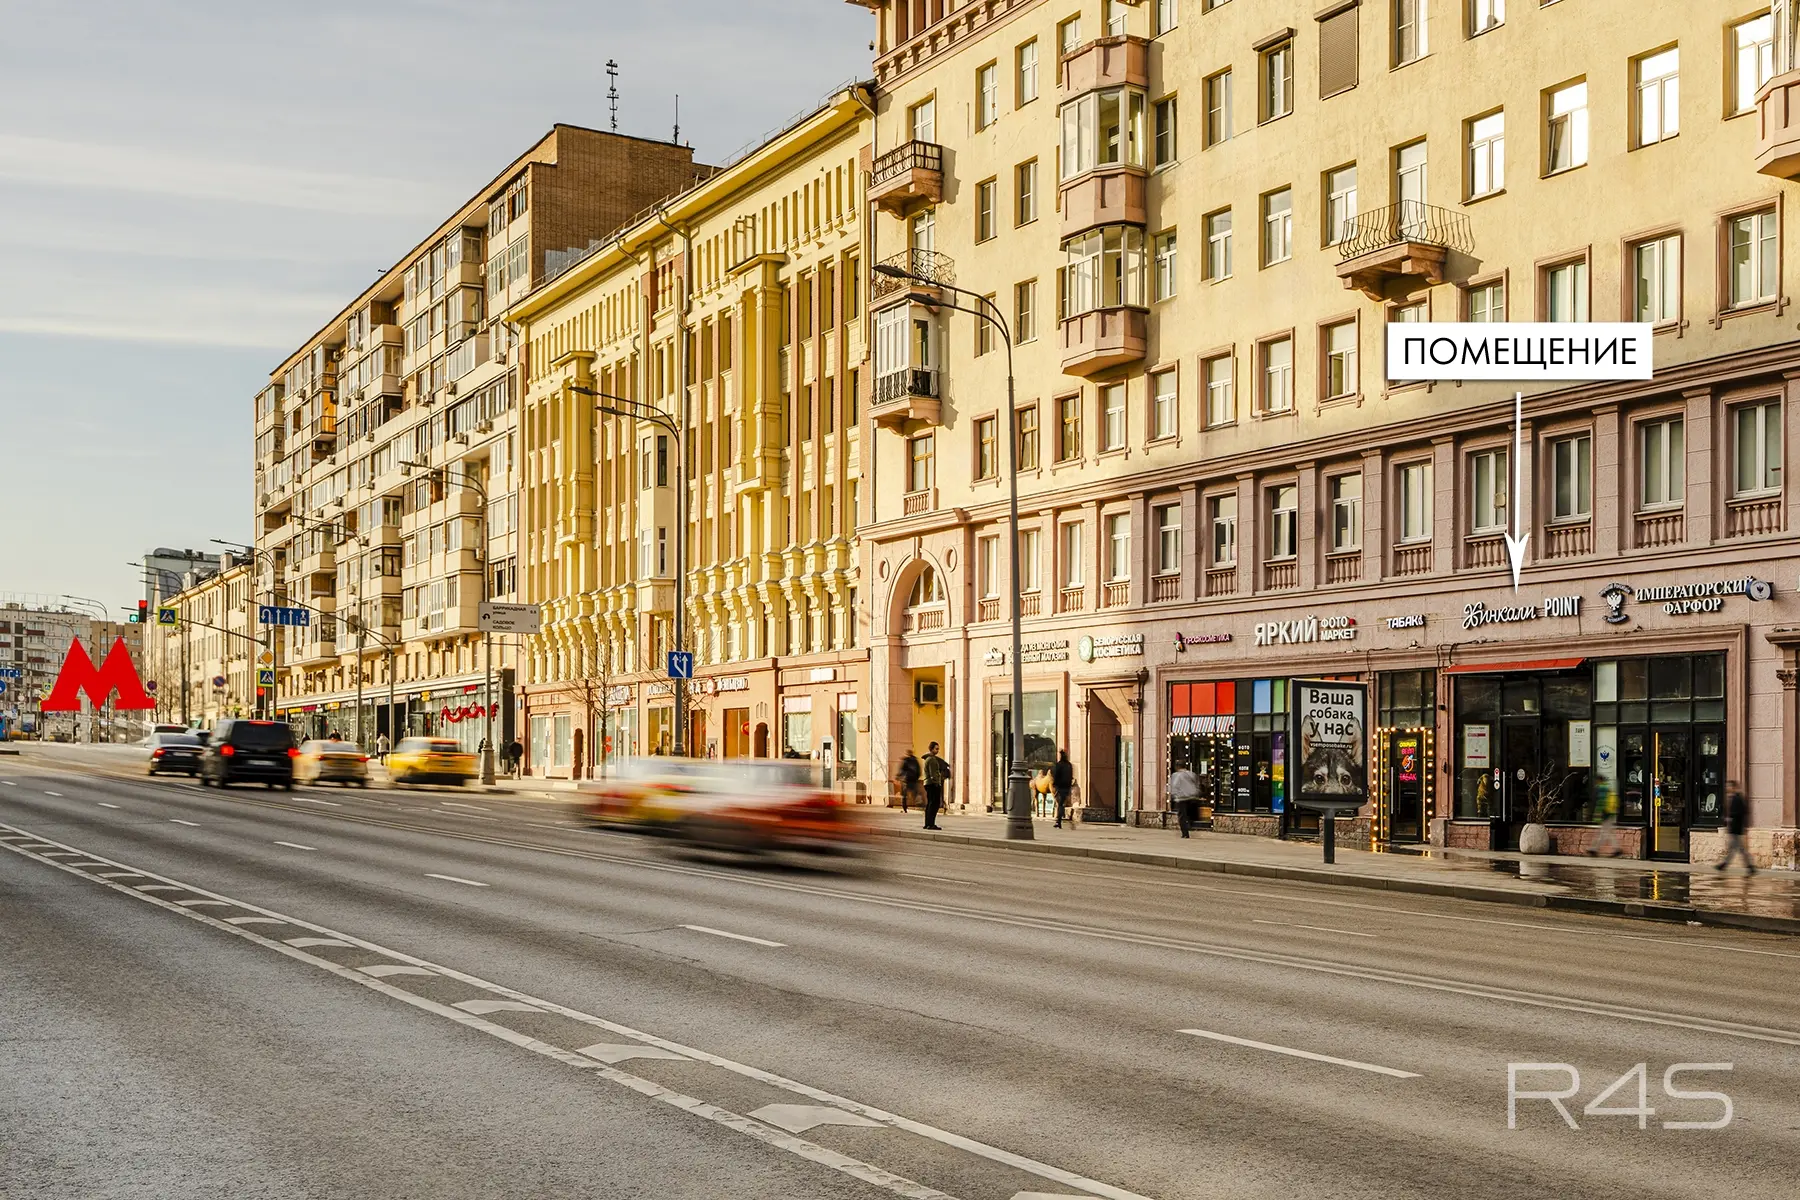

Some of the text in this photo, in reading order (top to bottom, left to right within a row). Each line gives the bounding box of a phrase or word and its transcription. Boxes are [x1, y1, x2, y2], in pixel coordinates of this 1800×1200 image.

[1462, 596, 1580, 630] Хинкали POINT
[1663, 598, 1722, 616] ФАРФОР
[1320, 616, 1348, 629] ФОТО
[1254, 615, 1318, 646] ЯРКИЙ
[1320, 628, 1356, 641] МАРКЕТ
[1093, 633, 1143, 647] БЕЛОРУССКАЯ
[1093, 644, 1142, 658] КОСМЕТИКА
[1310, 689, 1354, 706] Ваша
[1310, 707, 1354, 720] собака
[1310, 722, 1354, 738] у нас
